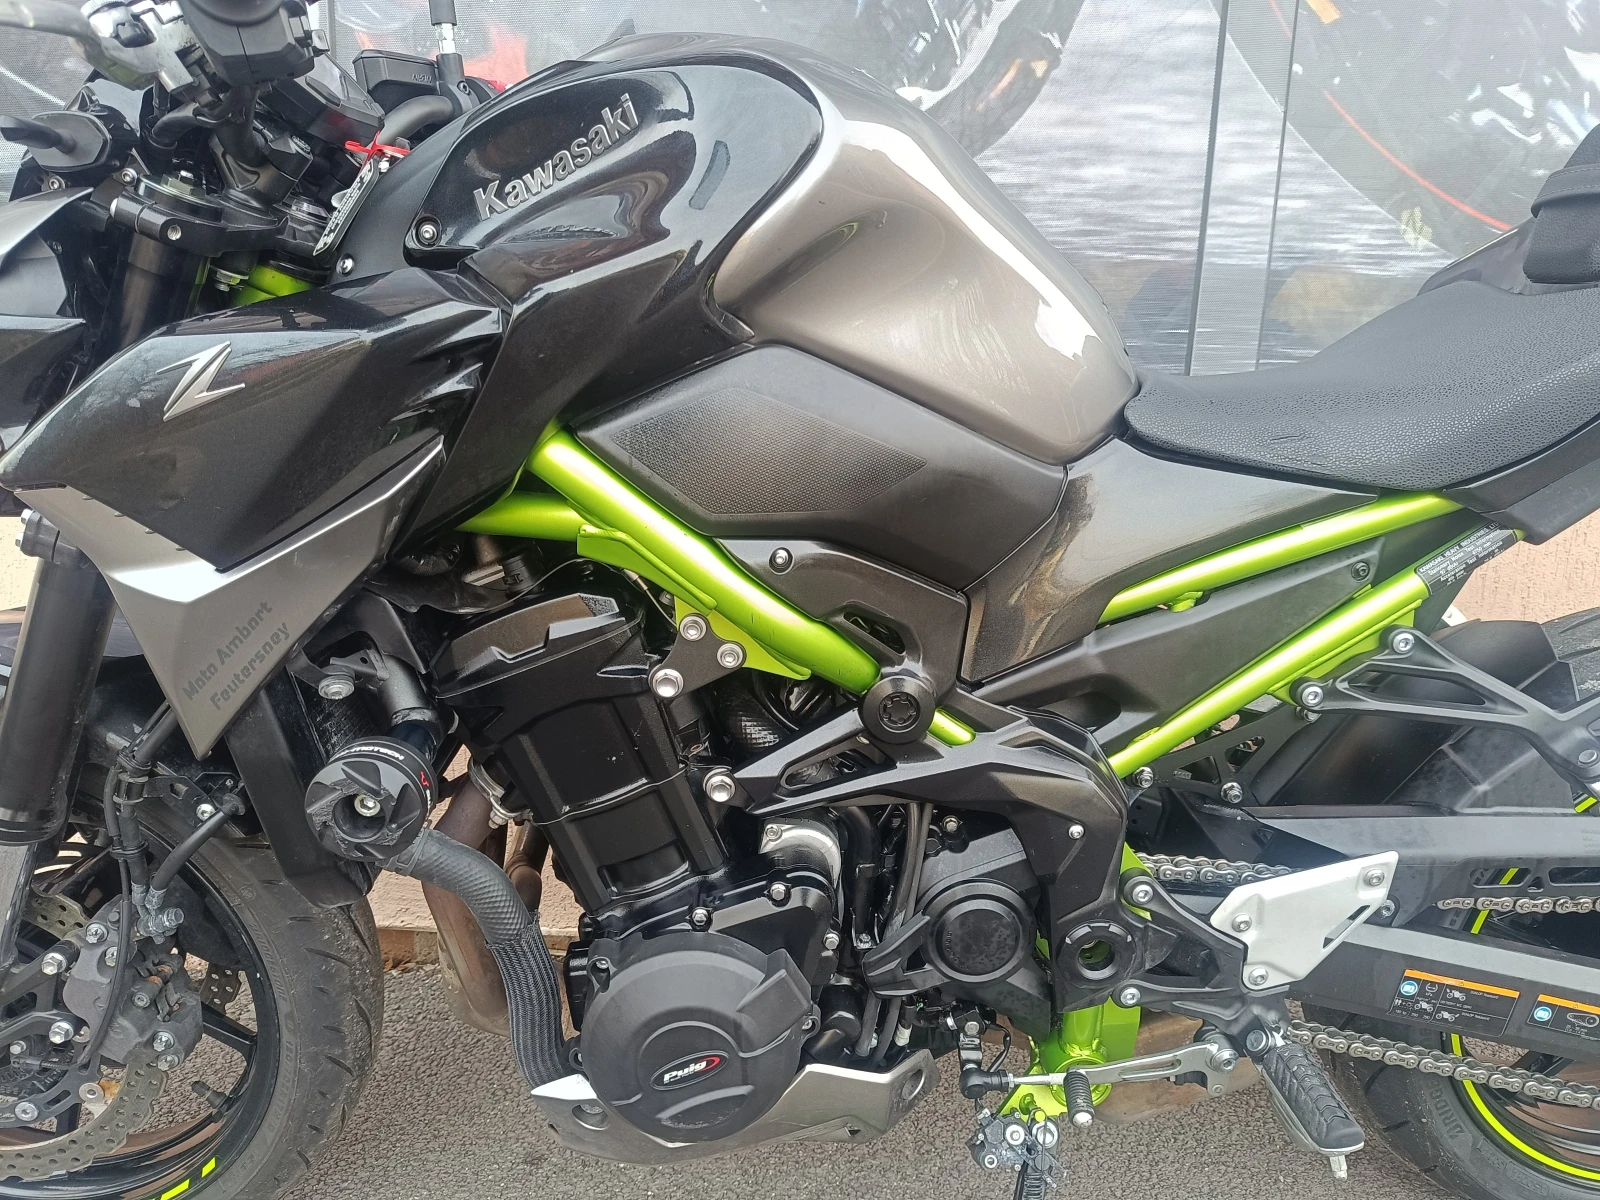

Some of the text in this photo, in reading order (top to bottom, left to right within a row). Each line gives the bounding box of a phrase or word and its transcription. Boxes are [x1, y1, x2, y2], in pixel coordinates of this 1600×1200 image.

[473, 93, 639, 221] Kawasaki
[1440, 563, 1465, 581] Acceleration
[1478, 540, 1502, 557] Information
[1444, 545, 1459, 556] HEAVY
[1451, 551, 1464, 561] Noise
[1476, 528, 1500, 545] Information
[182, 662, 218, 700] Moto
[664, 1060, 707, 1082] Puig
